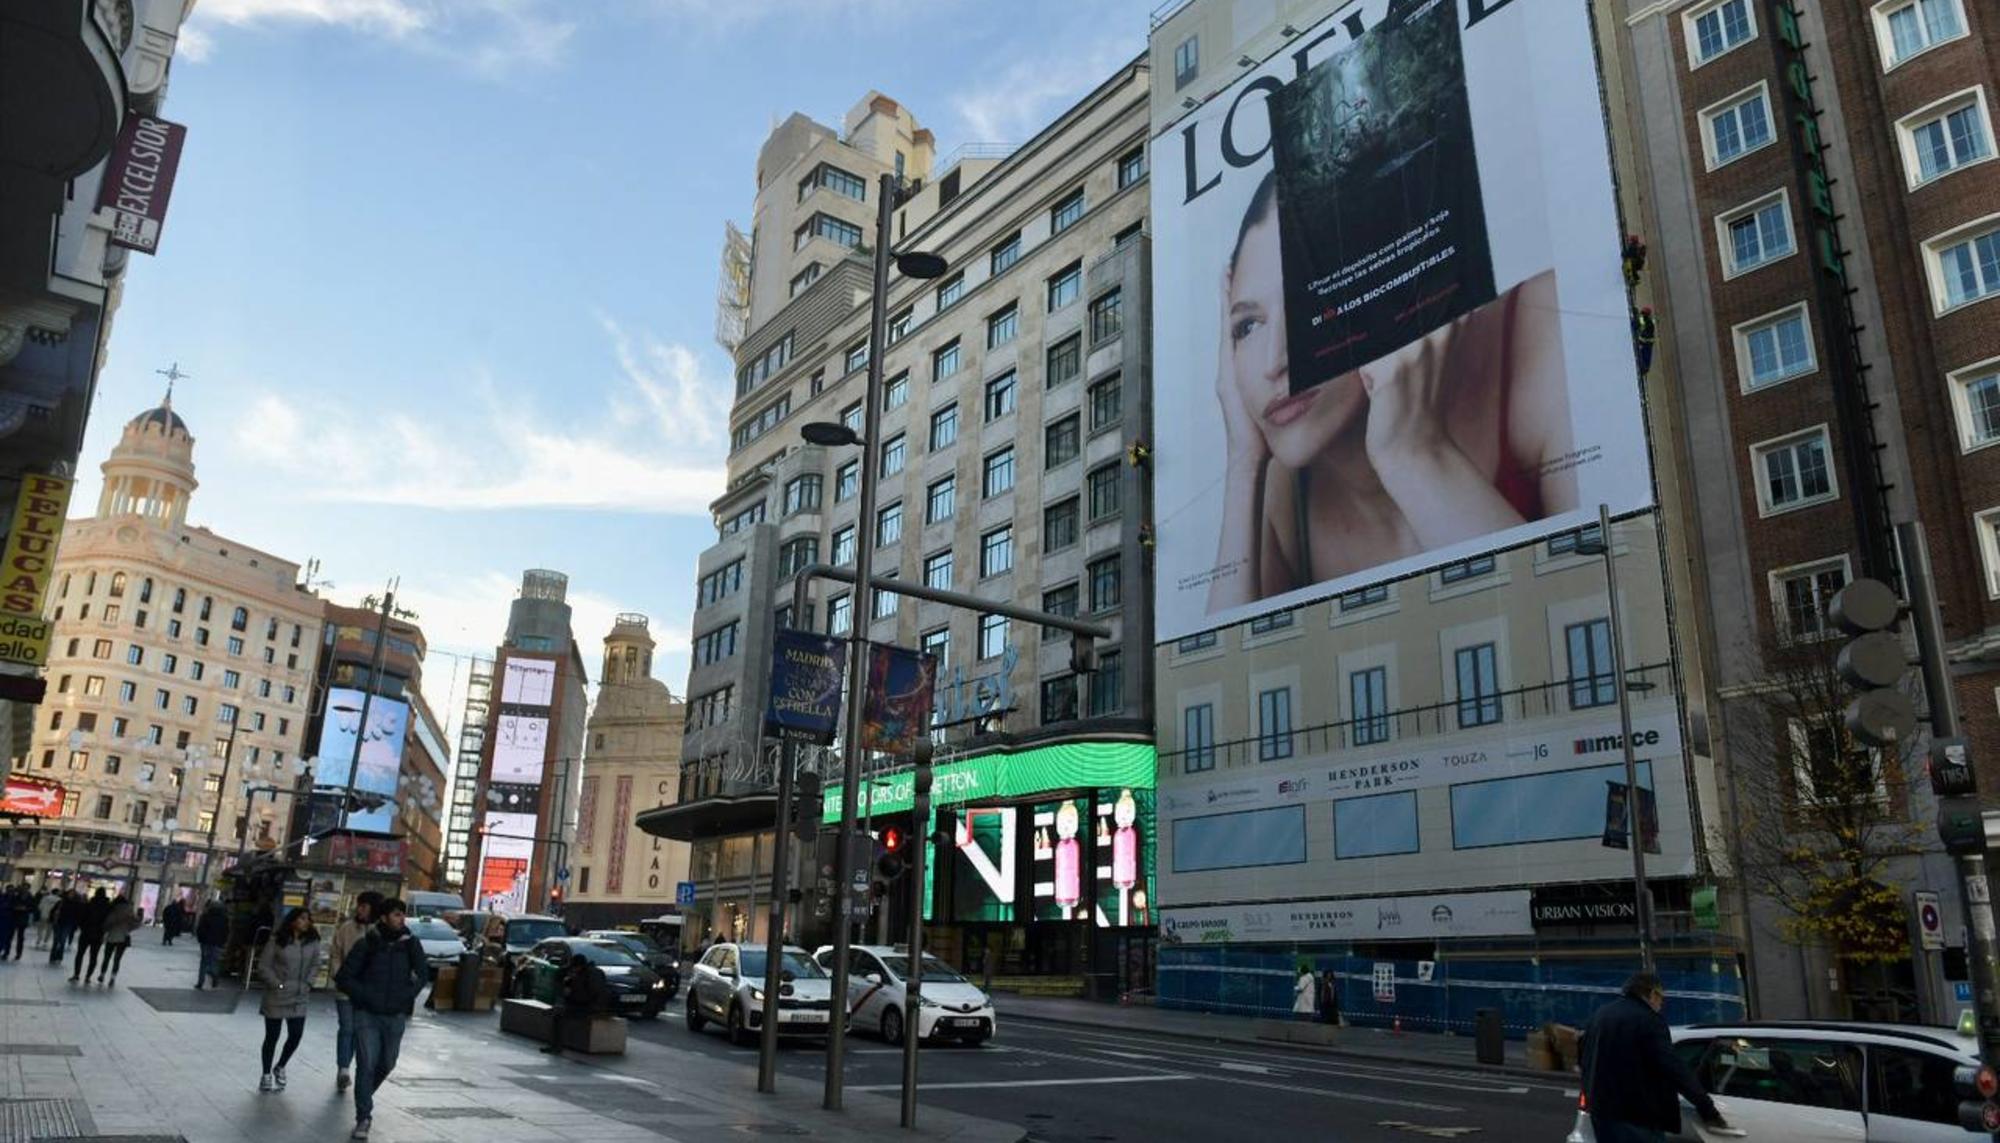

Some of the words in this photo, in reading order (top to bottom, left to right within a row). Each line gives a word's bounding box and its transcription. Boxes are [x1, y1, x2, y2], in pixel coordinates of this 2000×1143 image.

[117, 118, 169, 215] EXCELSIOR
[1343, 297, 1362, 312] LOS
[1363, 245, 1456, 302] BIOCOMBUSTIBLES
[2, 476, 65, 614] PELUCAS
[788, 687, 816, 702] CON
[774, 695, 833, 718] ESTRELLA
[1328, 757, 1421, 781] HENDERSON
[1442, 751, 1488, 768] TOUZA
[1354, 776, 1393, 790] PARK
[648, 780, 668, 889] CLAO
[1290, 911, 1354, 921] HENDERSON
[1533, 904, 1581, 920] URBAN
[1586, 902, 1635, 919] VISION
[1309, 920, 1337, 930] PARK
